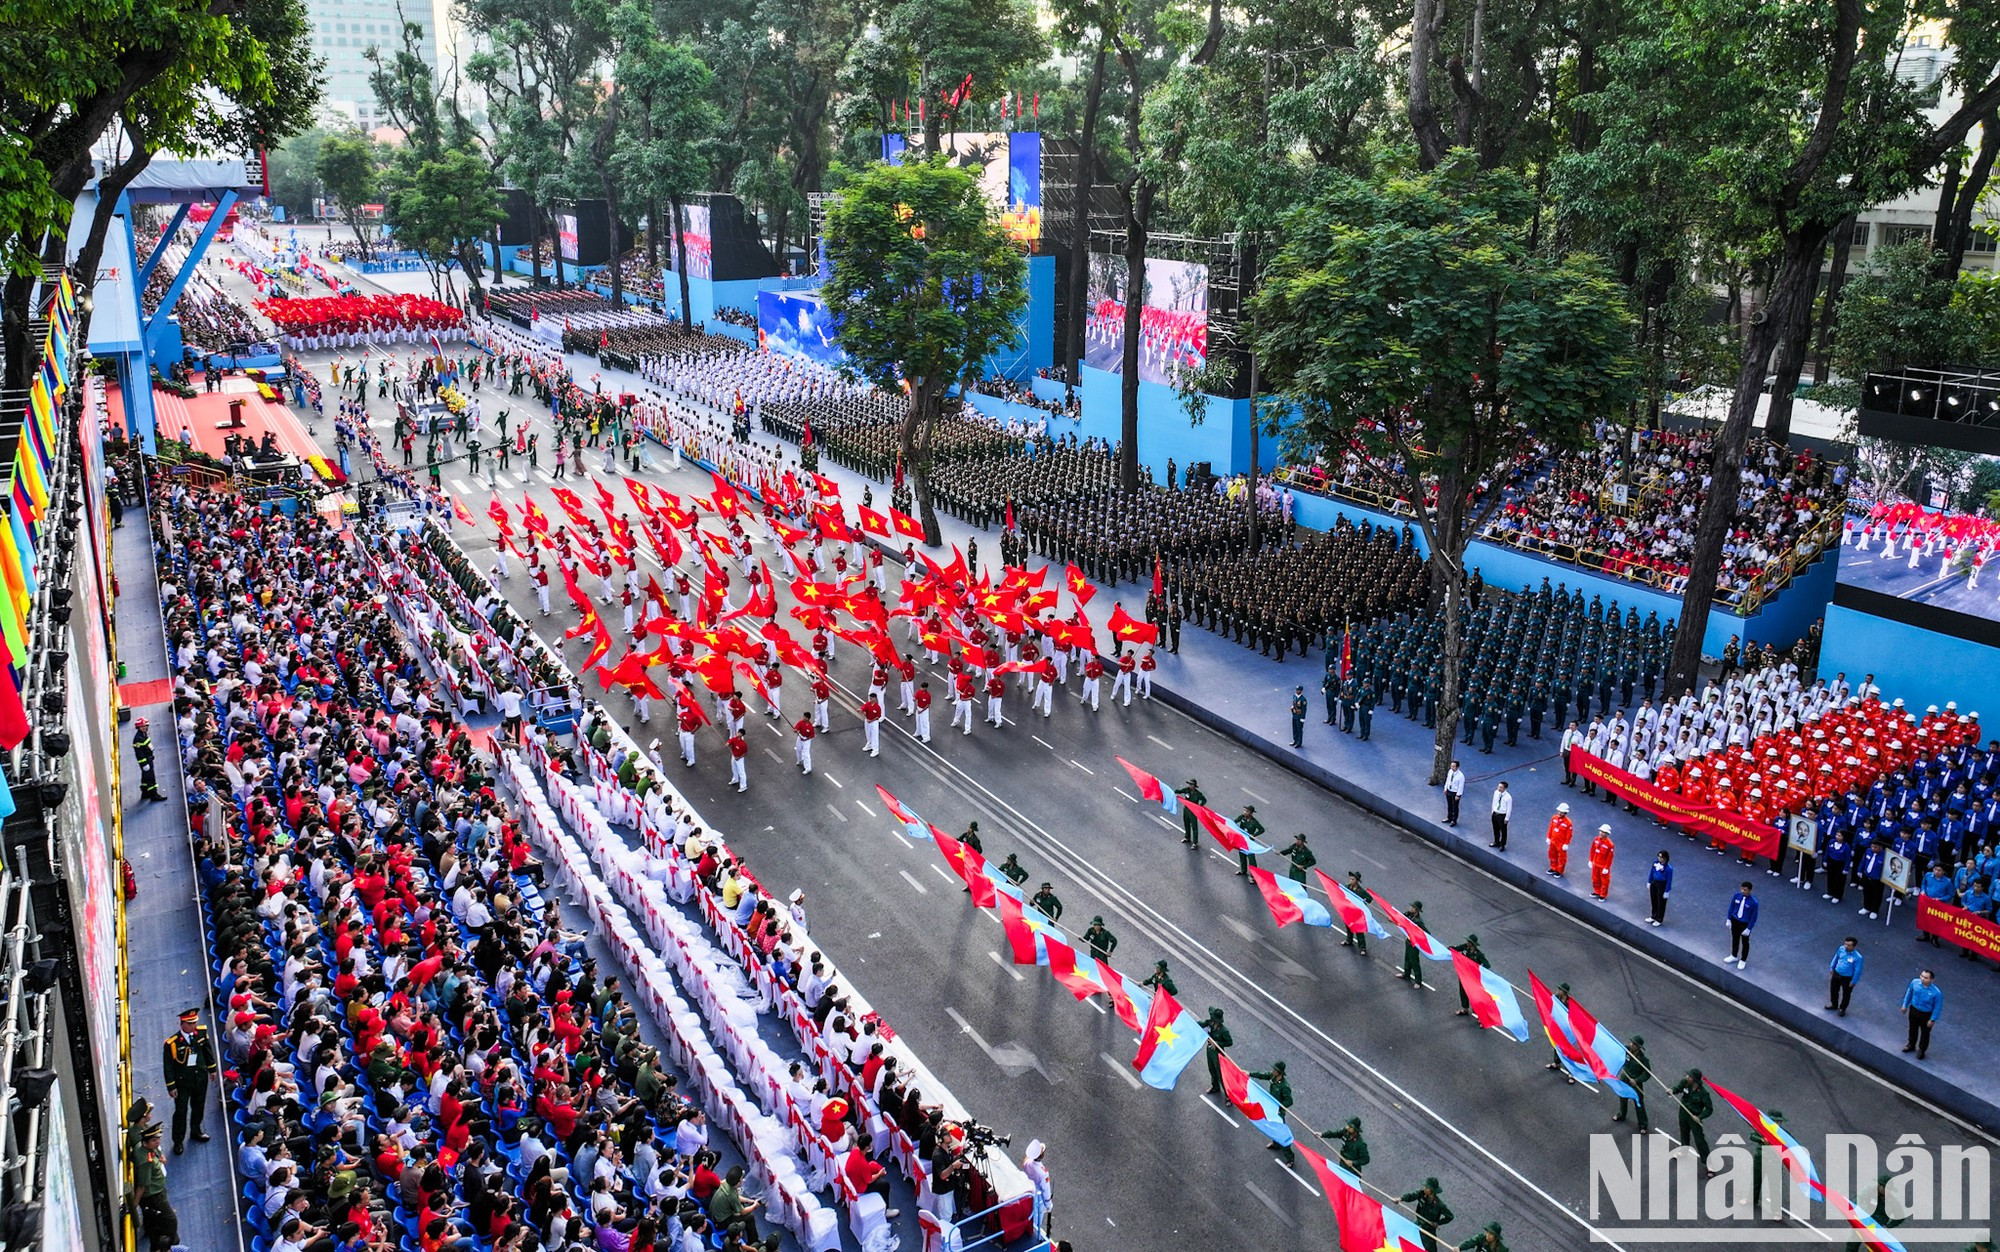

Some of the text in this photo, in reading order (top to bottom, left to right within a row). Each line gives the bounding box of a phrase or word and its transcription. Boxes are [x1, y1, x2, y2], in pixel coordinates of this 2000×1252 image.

[1603, 773, 1624, 787] CỘNG
[1624, 783, 1638, 795] SẢN
[1639, 790, 1653, 802] VIỆT
[1653, 797, 1670, 809] NAM
[1718, 819, 1740, 835] MUÔN
[1927, 907, 1954, 922] NHIỆT
[1955, 917, 1973, 929] LIỆT
[1954, 927, 1988, 947] THỐNG
